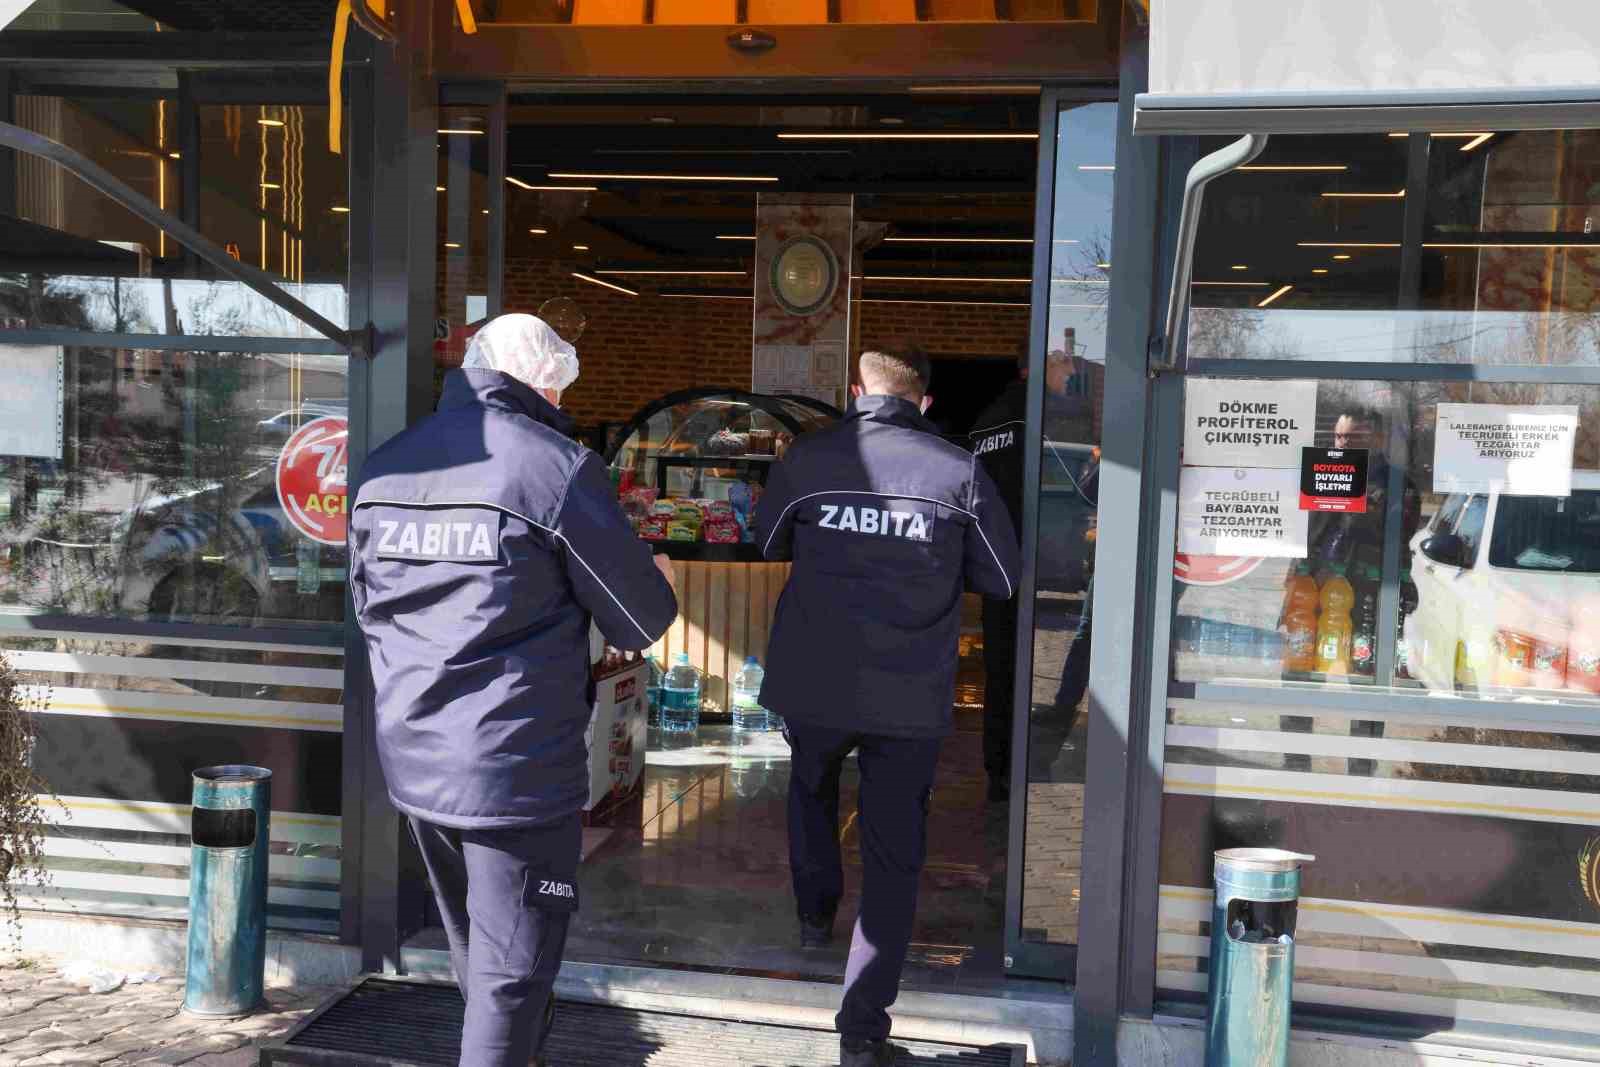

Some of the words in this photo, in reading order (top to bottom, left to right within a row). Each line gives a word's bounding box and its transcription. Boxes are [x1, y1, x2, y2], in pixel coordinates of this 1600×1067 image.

[1219, 400, 1278, 414] DÖKME
[1197, 416, 1298, 430] PROFİTEROL
[1205, 431, 1290, 447] ÇIKMIŞTIR
[1522, 432, 1559, 440] ERKEK
[973, 430, 1014, 456] ZABITA
[1475, 440, 1541, 449] TEZGAHTAR
[1315, 473, 1353, 482] DUYARLI
[1315, 480, 1352, 492] İŞLETME
[1205, 490, 1280, 502] TECRÜBELİ
[1205, 503, 1279, 514] BAY/BAYAN
[818, 504, 927, 539] ZABITA
[1201, 515, 1282, 527] TEZGAHTAR
[377, 520, 494, 556] ZABITA
[1199, 527, 1268, 539] ARIYORUZ
[539, 880, 575, 898] ZABITA
